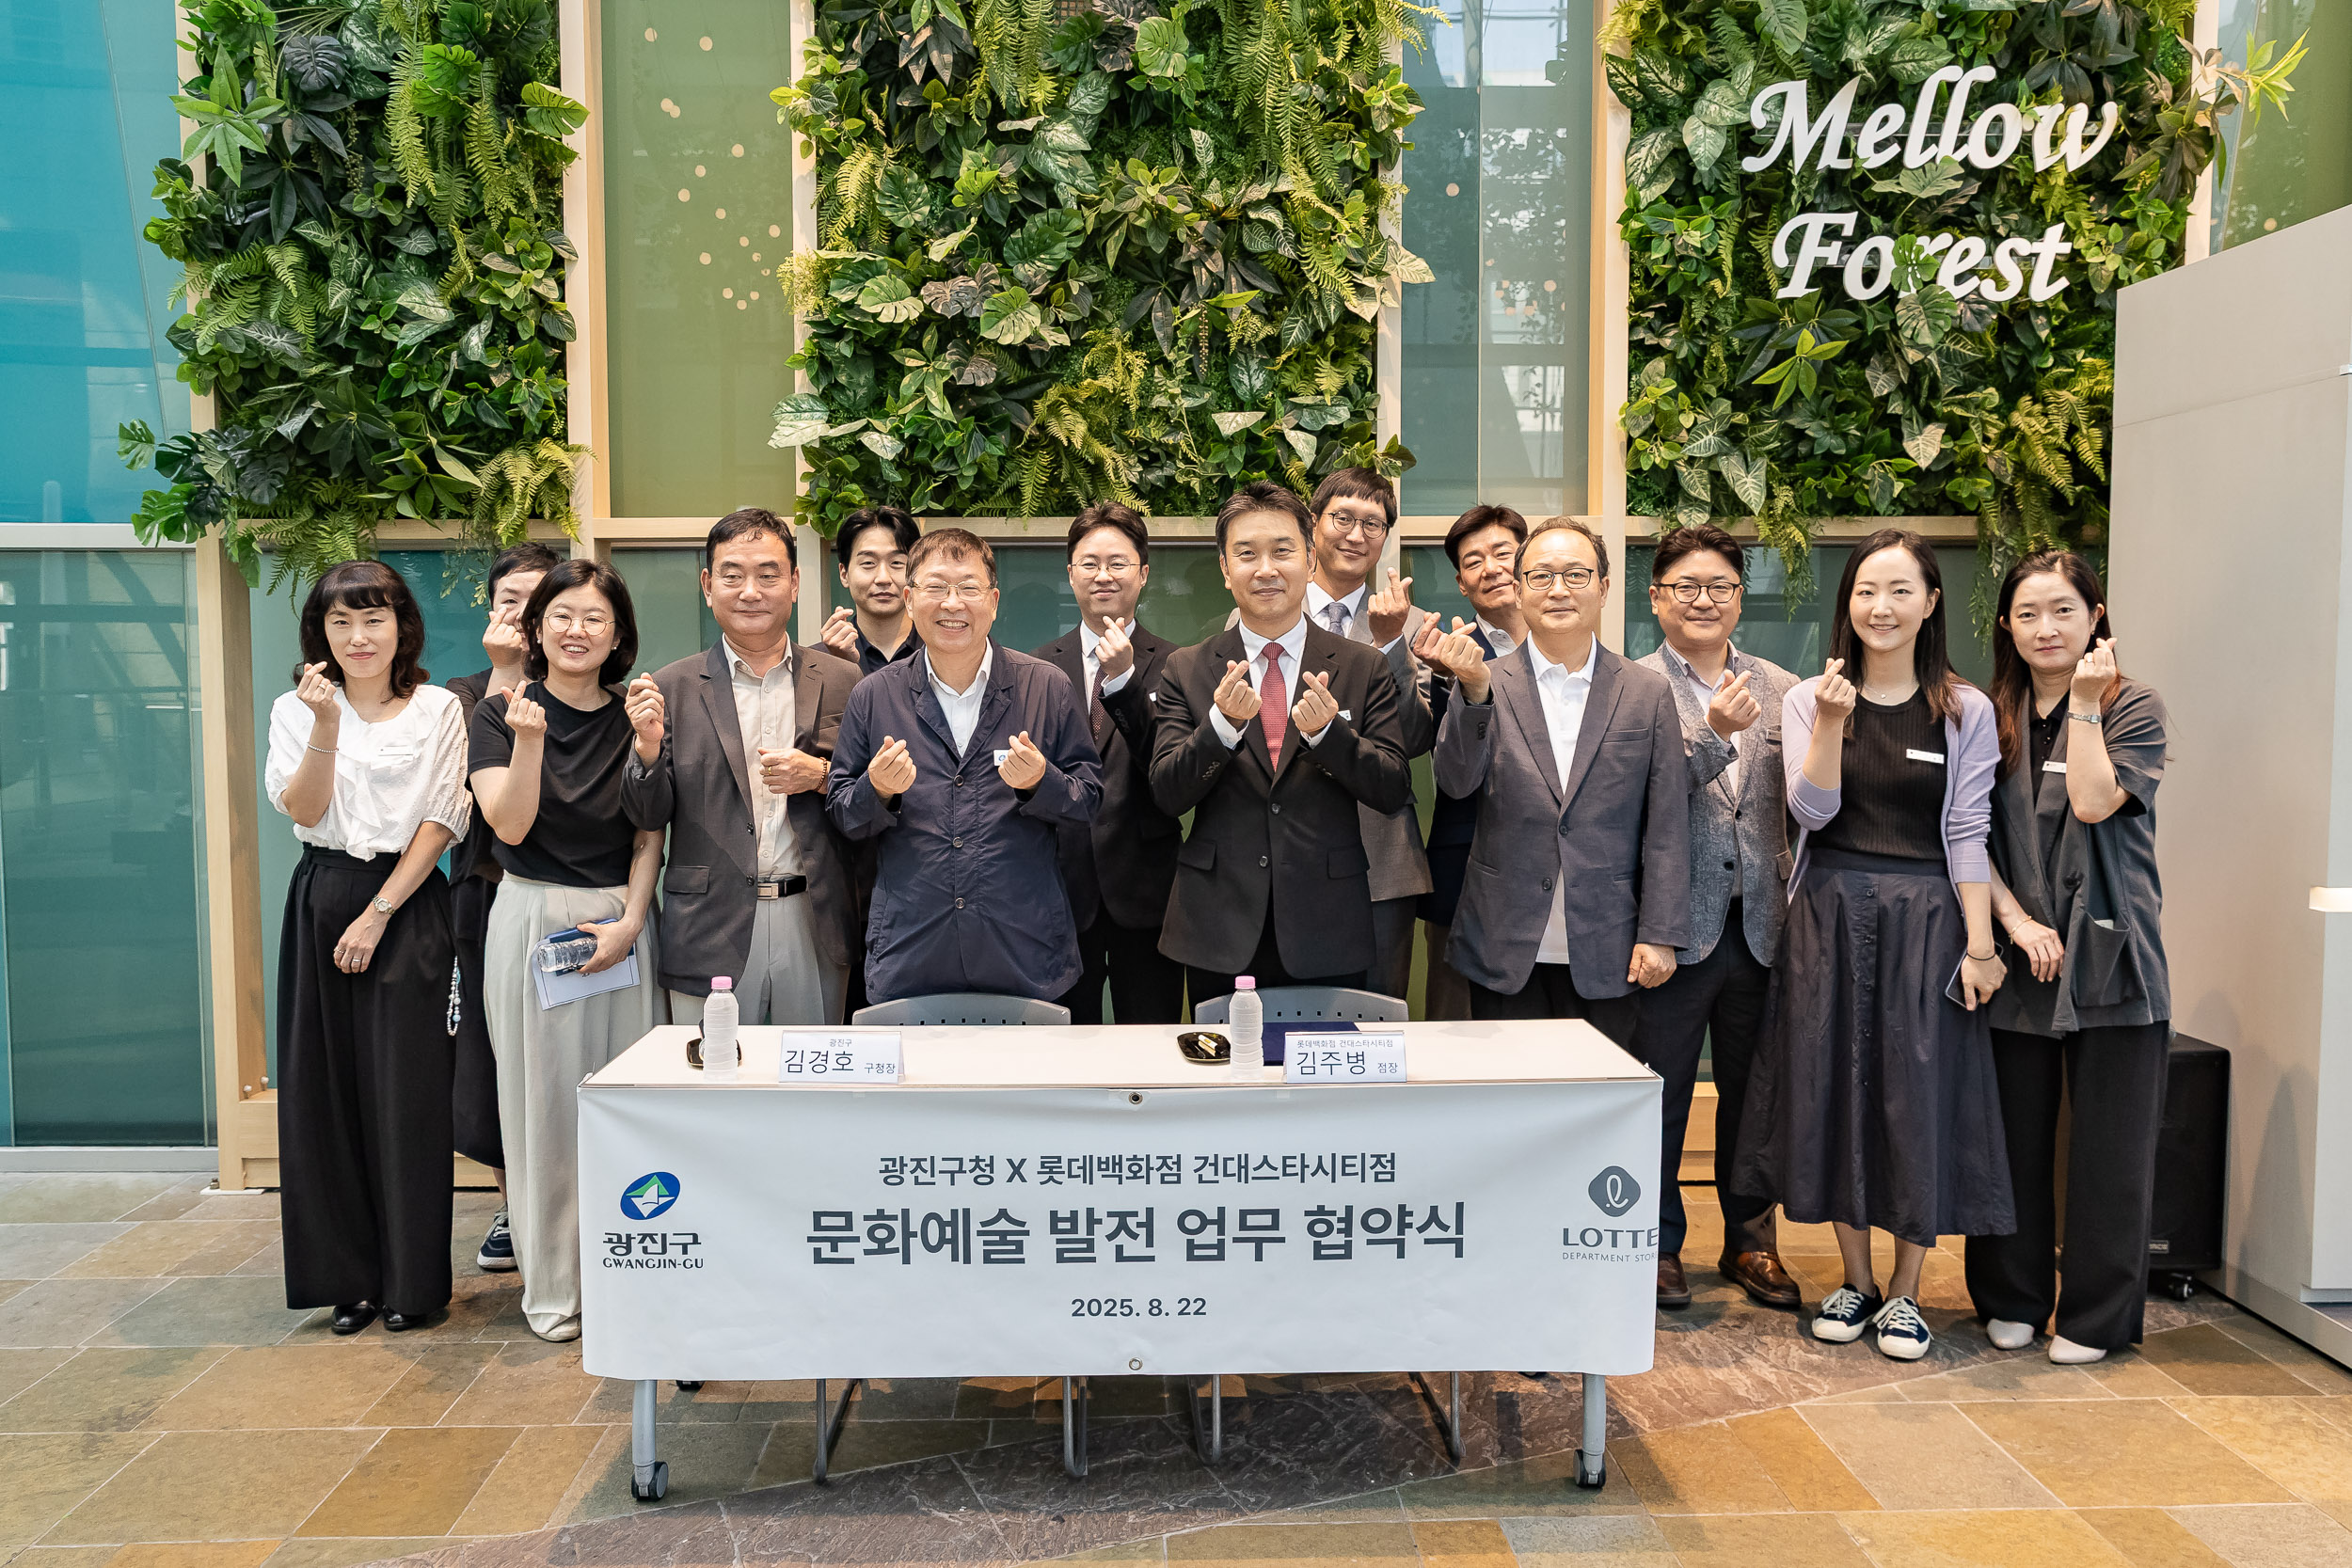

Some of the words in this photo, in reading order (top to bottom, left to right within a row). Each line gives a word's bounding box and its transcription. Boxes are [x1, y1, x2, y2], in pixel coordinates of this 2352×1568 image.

[1741, 65, 2119, 175] Mellow
[829, 1038, 852, 1047] 광진구
[1297, 1039, 1336, 1048] 롯데백화점
[1340, 1038, 1393, 1048] 건대스타시티점
[785, 1050, 854, 1074] 김경호
[864, 1062, 896, 1074] 구청장
[1296, 1051, 1366, 1076] 김주병
[1377, 1062, 1398, 1074] 점장
[879, 1154, 994, 1187] 광진구청
[1006, 1158, 1028, 1183] X
[1036, 1153, 1182, 1186] 롯데백화점
[1193, 1151, 1397, 1184] 건대스타시티점
[602, 1232, 702, 1256] 광진구
[806, 1207, 1031, 1265] 문화예술
[1049, 1206, 1156, 1264] 발전
[1176, 1206, 1286, 1262] 업무
[1303, 1201, 1466, 1261] 협약식
[1563, 1227, 1658, 1249] LOTTE
[602, 1257, 704, 1270] GWANGJIN-GU
[1562, 1252, 1630, 1262] DEPARTMENT
[1071, 1298, 1140, 1318] 2025.
[1148, 1298, 1169, 1317] 8.
[1177, 1297, 1207, 1317] 22
